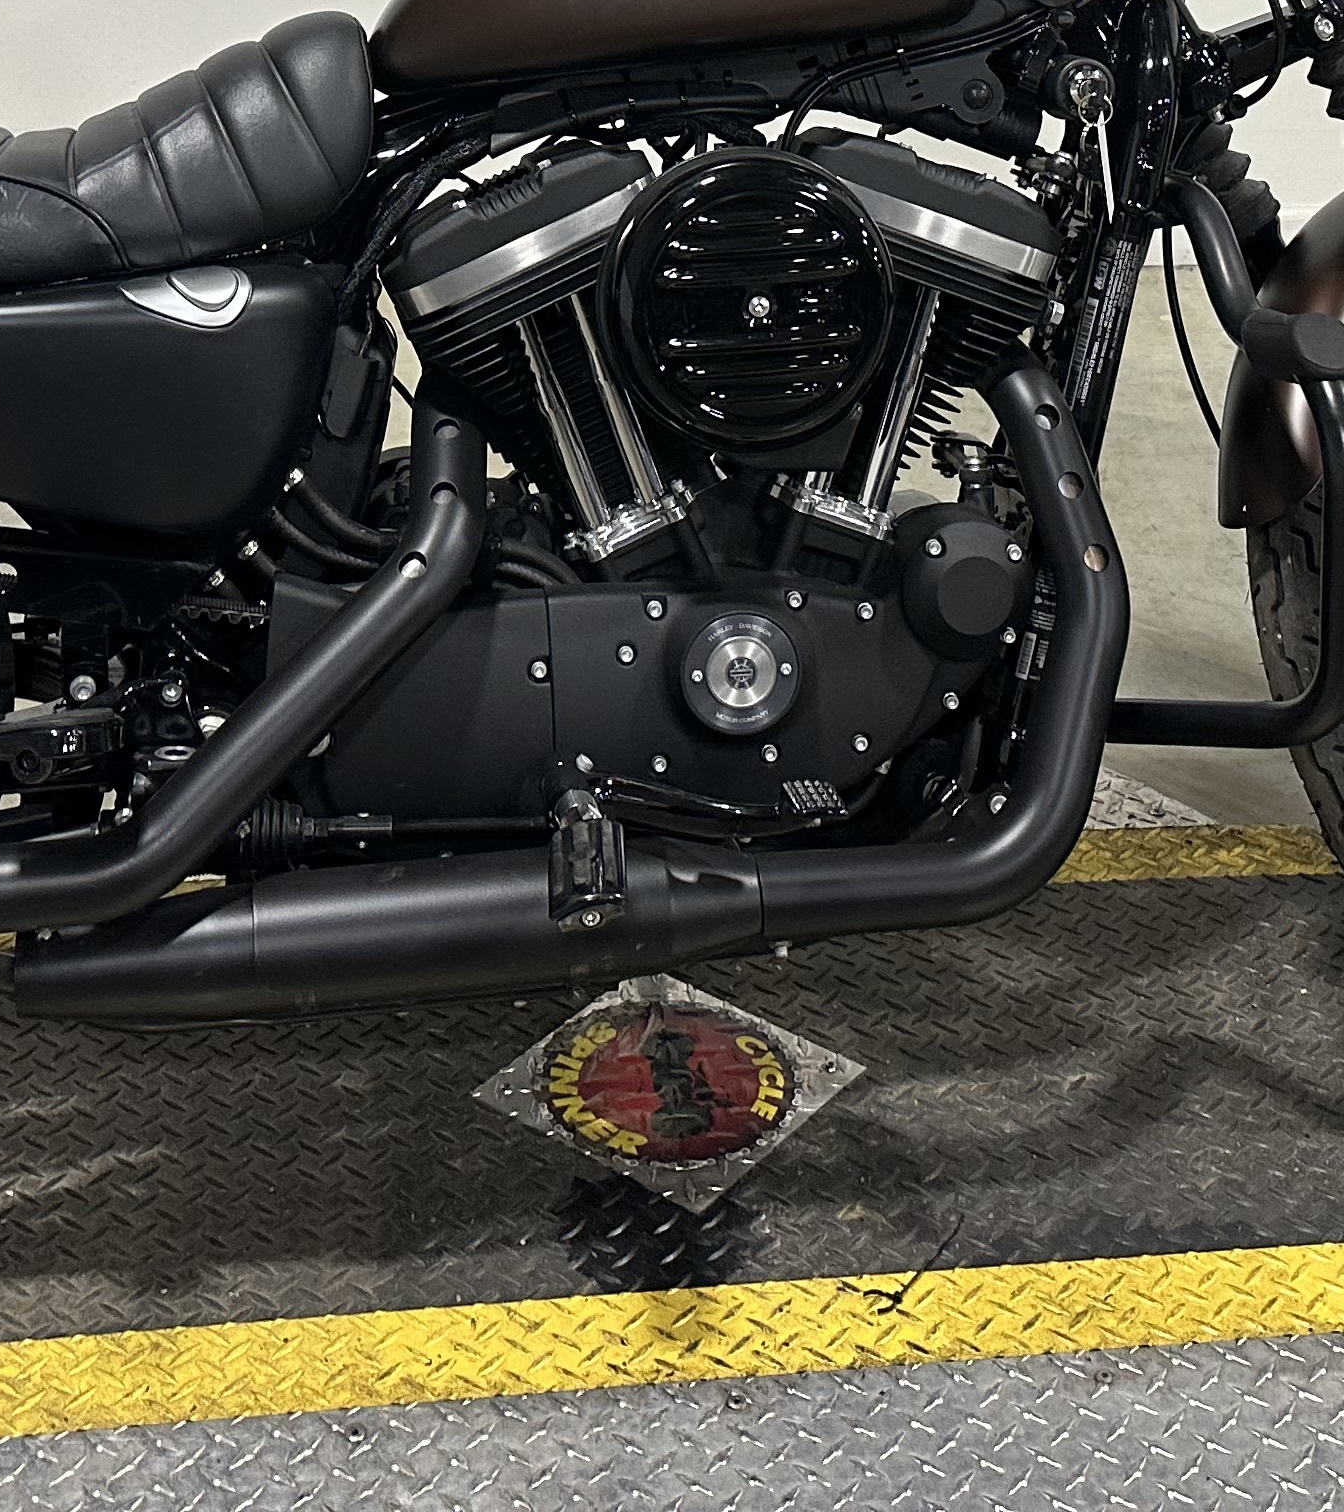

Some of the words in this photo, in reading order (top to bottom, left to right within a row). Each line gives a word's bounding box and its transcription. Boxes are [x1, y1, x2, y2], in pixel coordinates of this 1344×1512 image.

[708, 625, 734, 641] HARLEY
[549, 1021, 649, 1156] SPINNER
[735, 1034, 784, 1123] CYCLE
